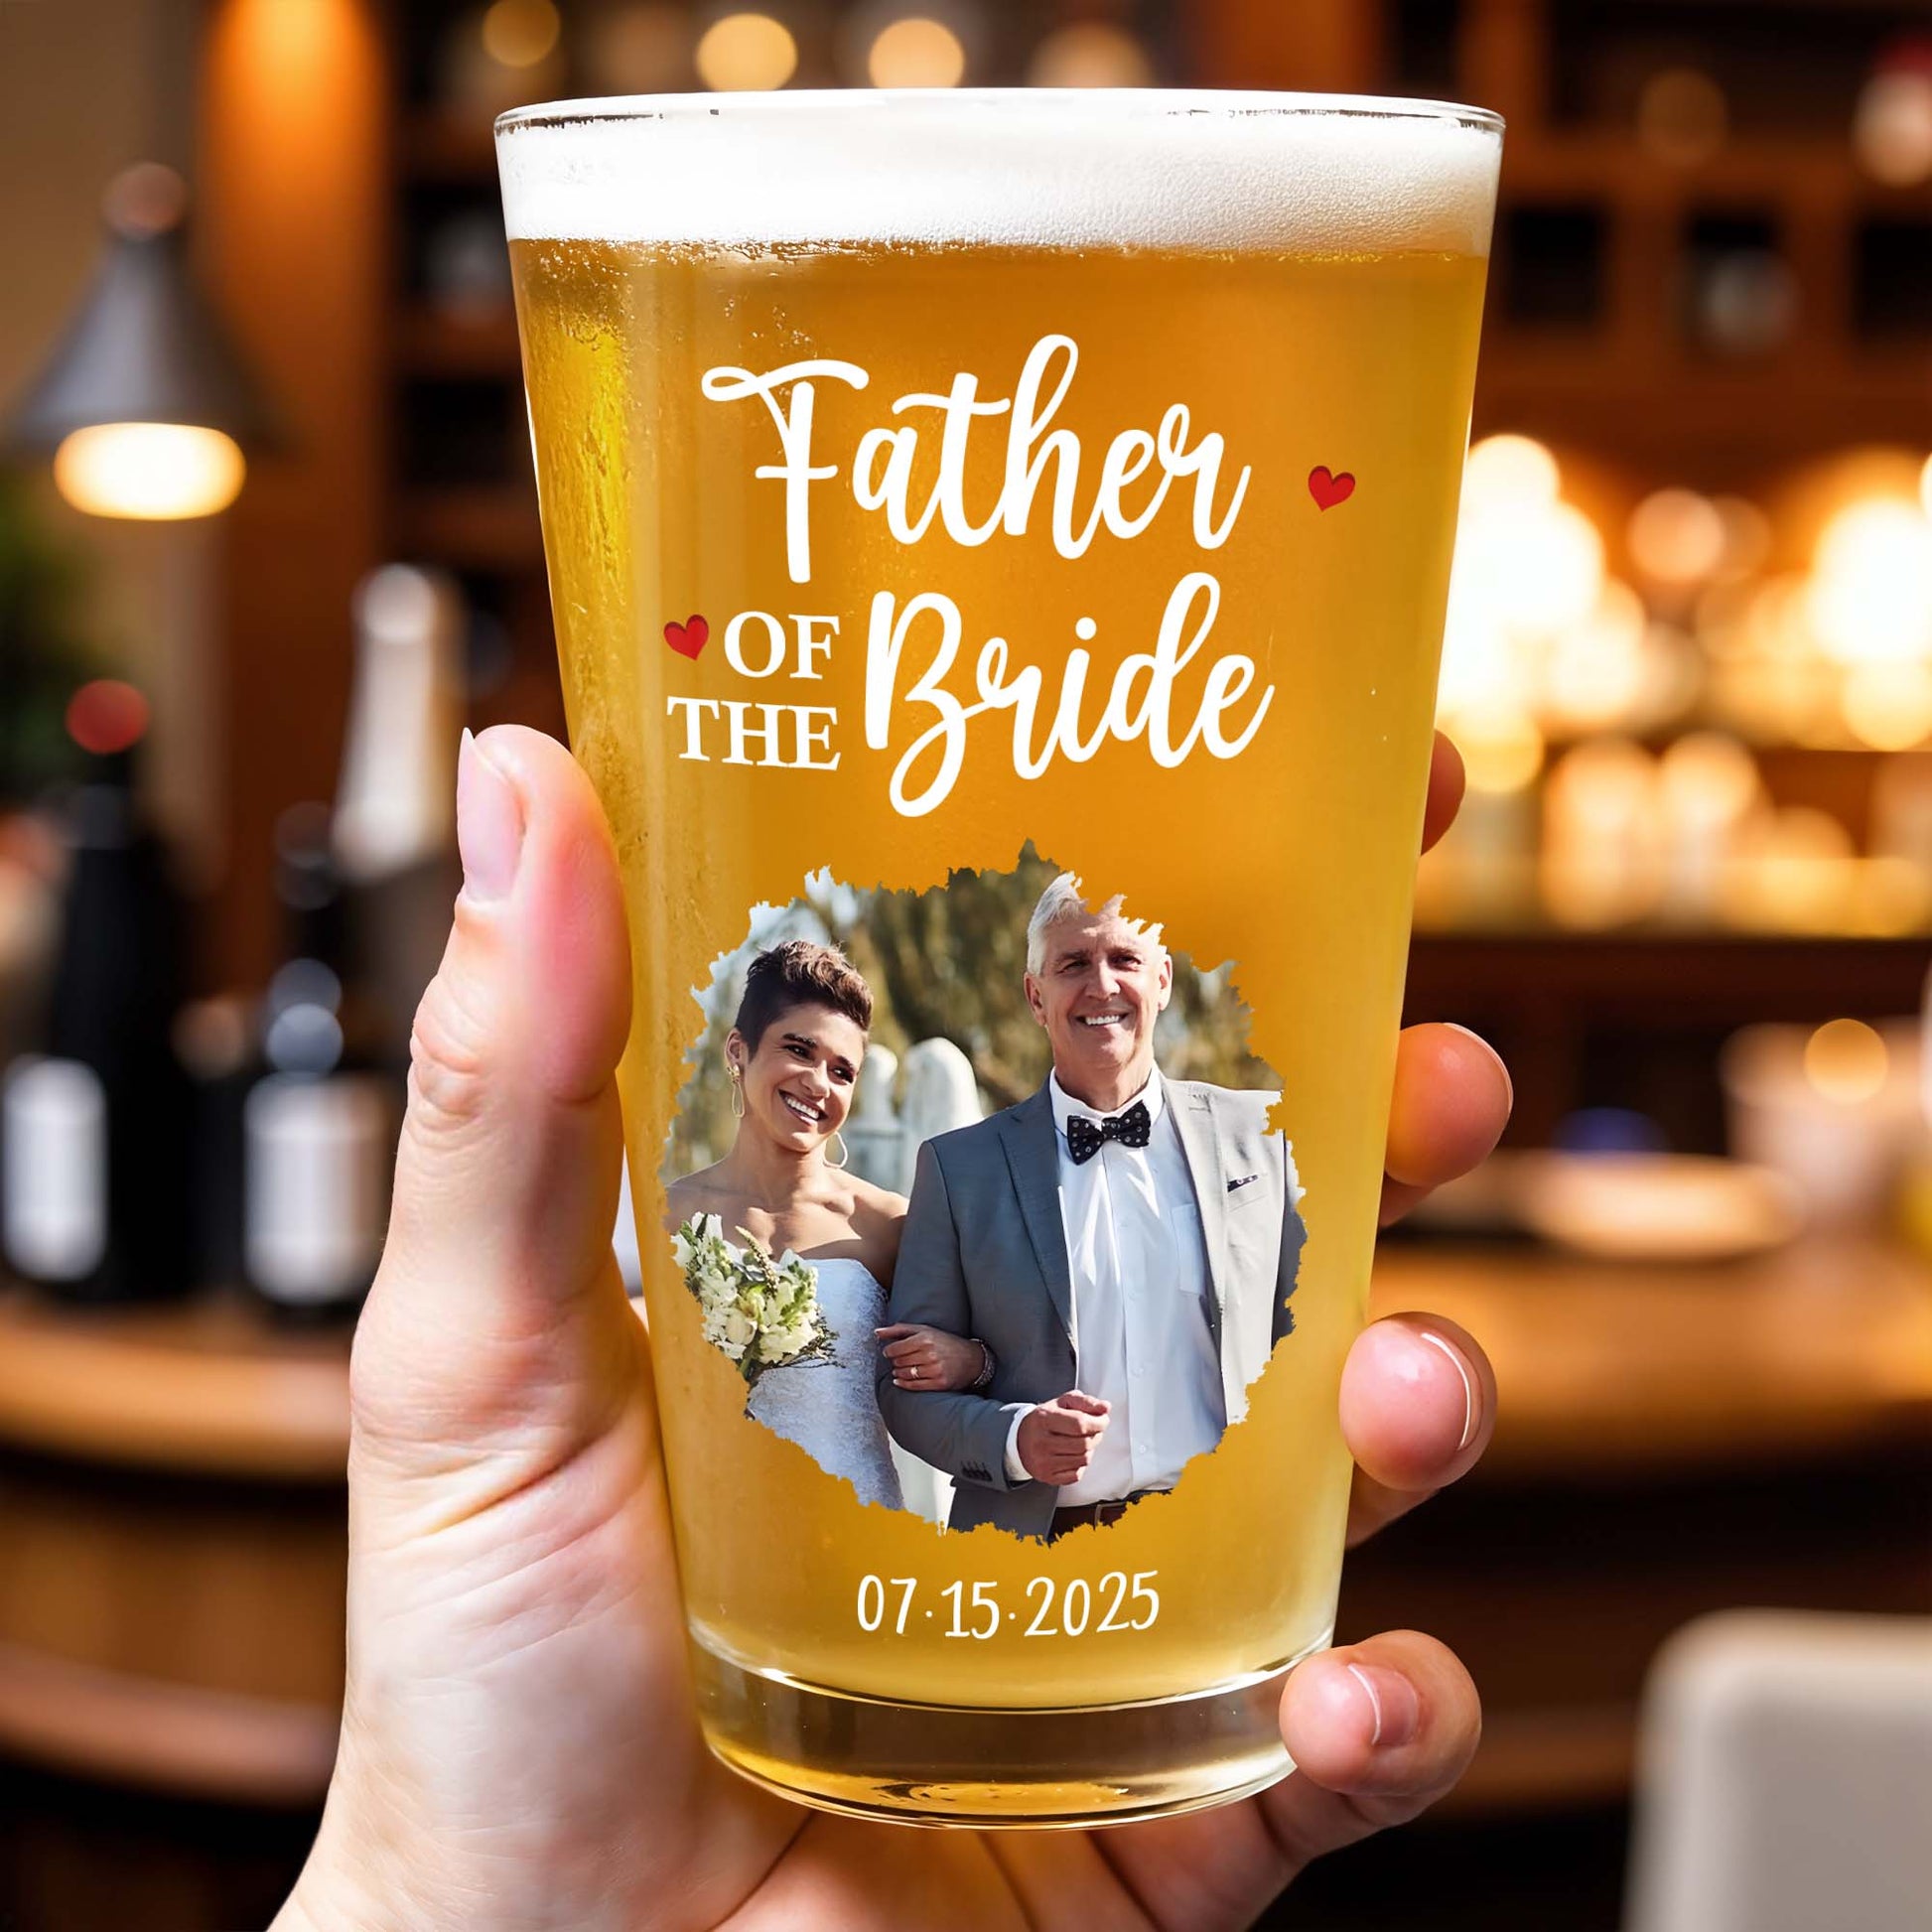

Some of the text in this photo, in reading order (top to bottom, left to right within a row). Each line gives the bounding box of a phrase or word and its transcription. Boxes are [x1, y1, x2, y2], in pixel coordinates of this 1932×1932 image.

[701, 334, 1251, 584] Father
[724, 610, 840, 680] OF
[865, 572, 1275, 818] Bride
[666, 695, 841, 771] THE
